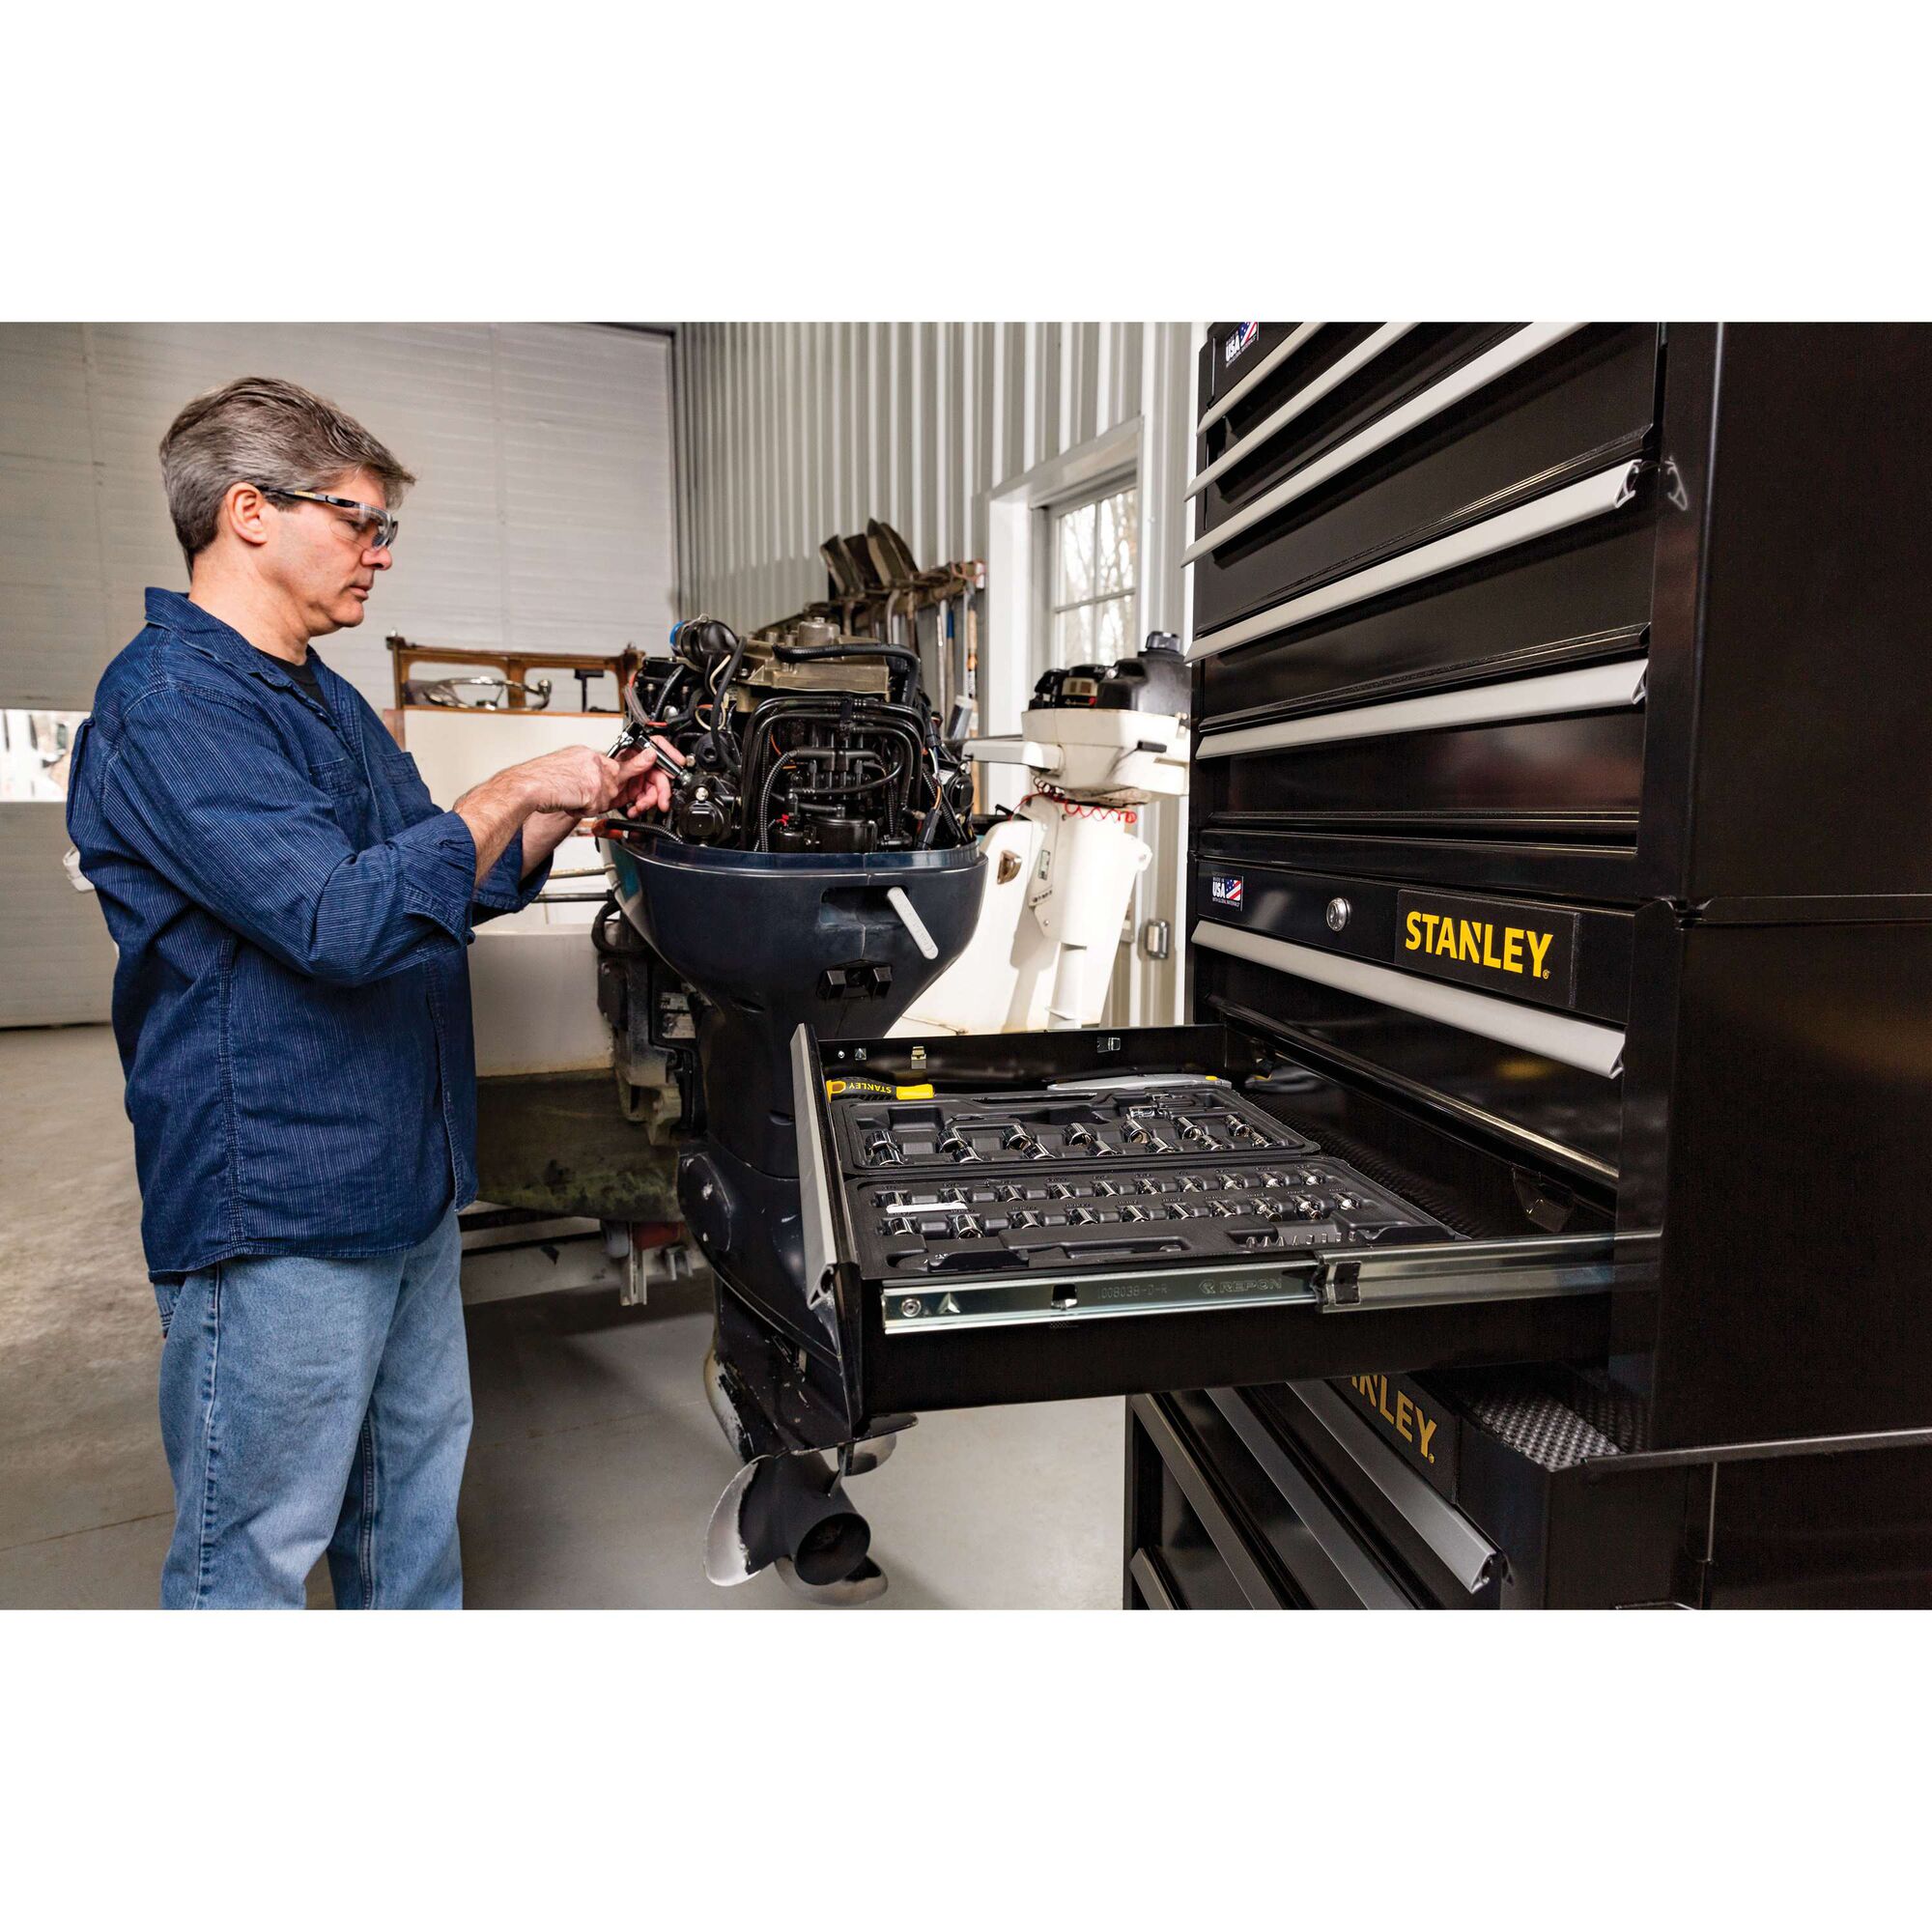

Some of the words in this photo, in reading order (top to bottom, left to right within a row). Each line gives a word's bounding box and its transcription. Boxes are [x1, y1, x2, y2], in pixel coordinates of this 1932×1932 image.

[1226, 334, 1240, 362] USA
[1212, 881, 1226, 899] USA
[1406, 911, 1553, 979] STANLEY
[849, 1082, 892, 1094] STANLEY
[1219, 1278, 1282, 1293] REPON
